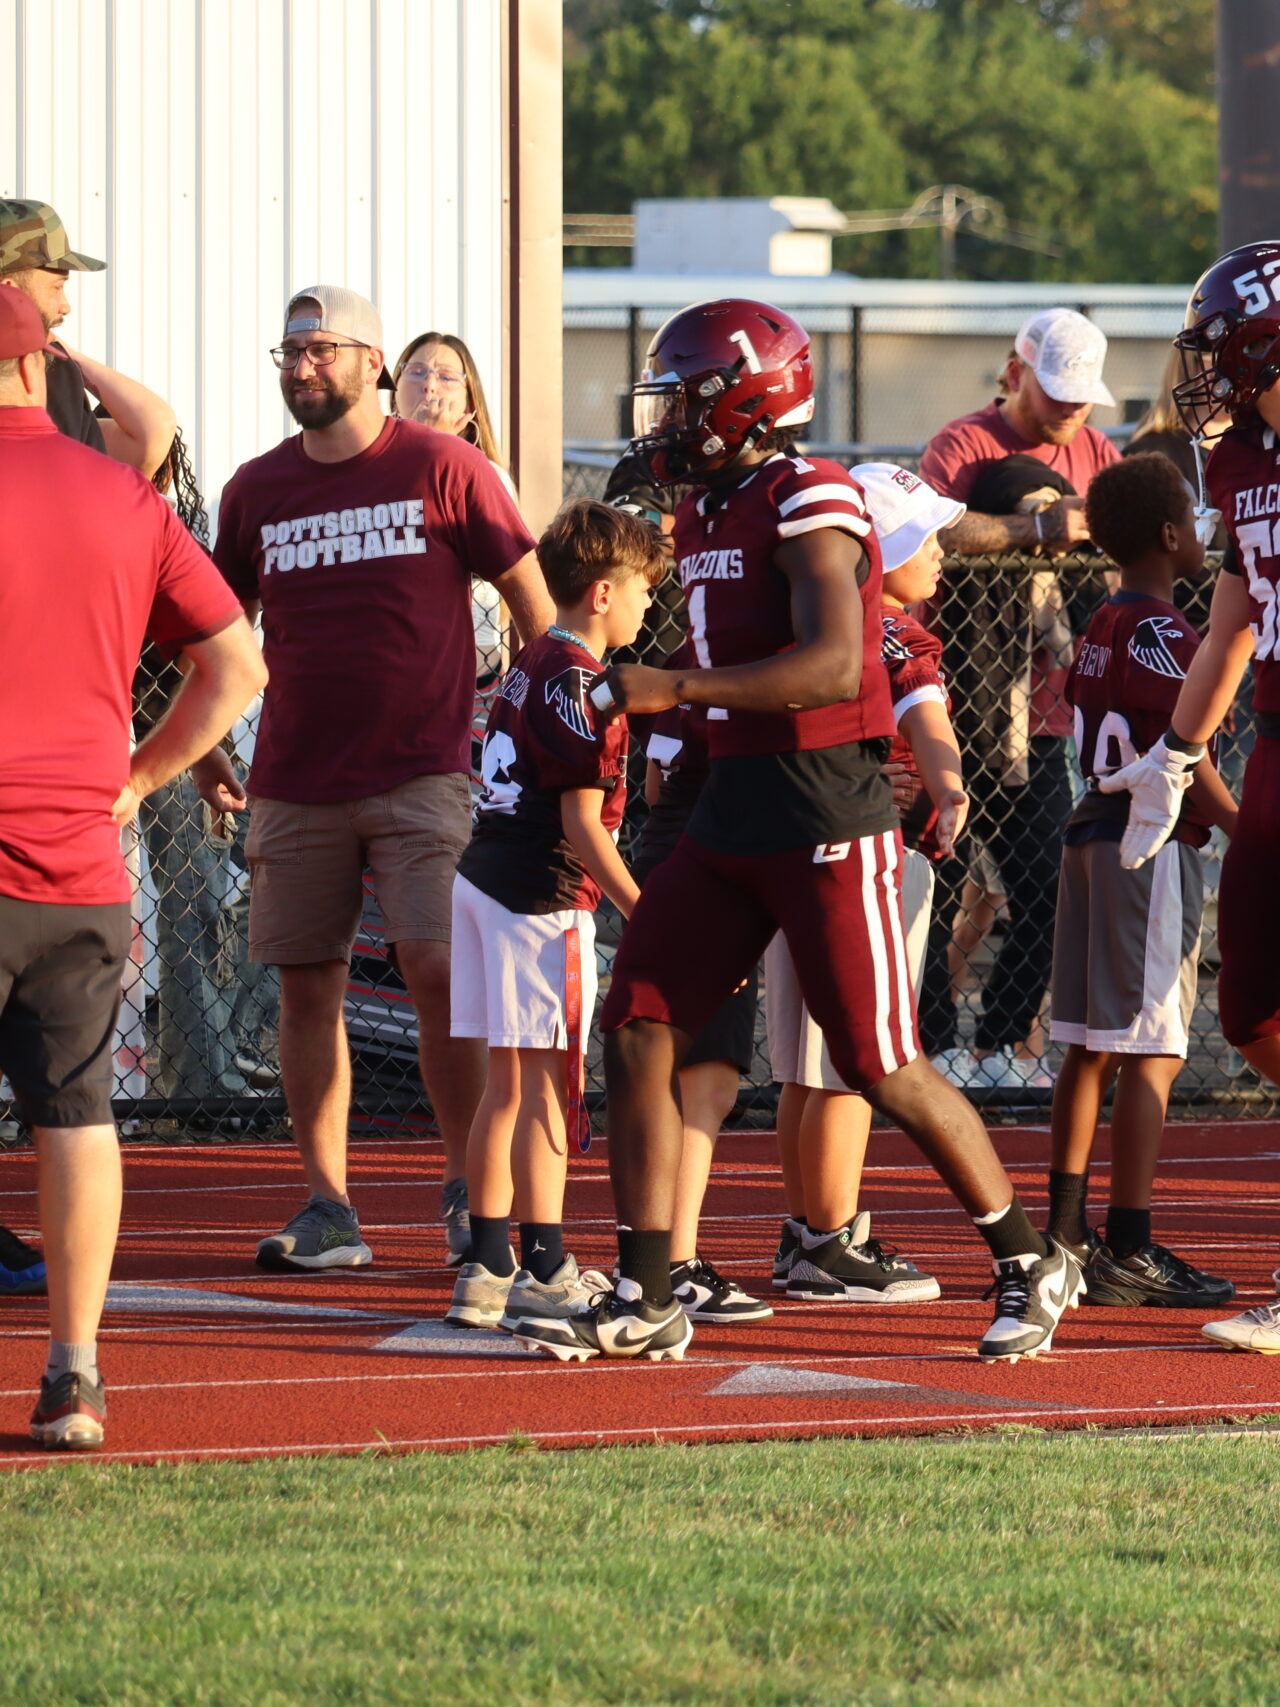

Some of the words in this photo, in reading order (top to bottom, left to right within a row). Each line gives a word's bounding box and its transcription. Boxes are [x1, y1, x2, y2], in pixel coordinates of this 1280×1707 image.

[728, 329, 763, 375] 1
[260, 499, 425, 550] POTTSGROVE
[264, 526, 427, 576] FOOTBALL
